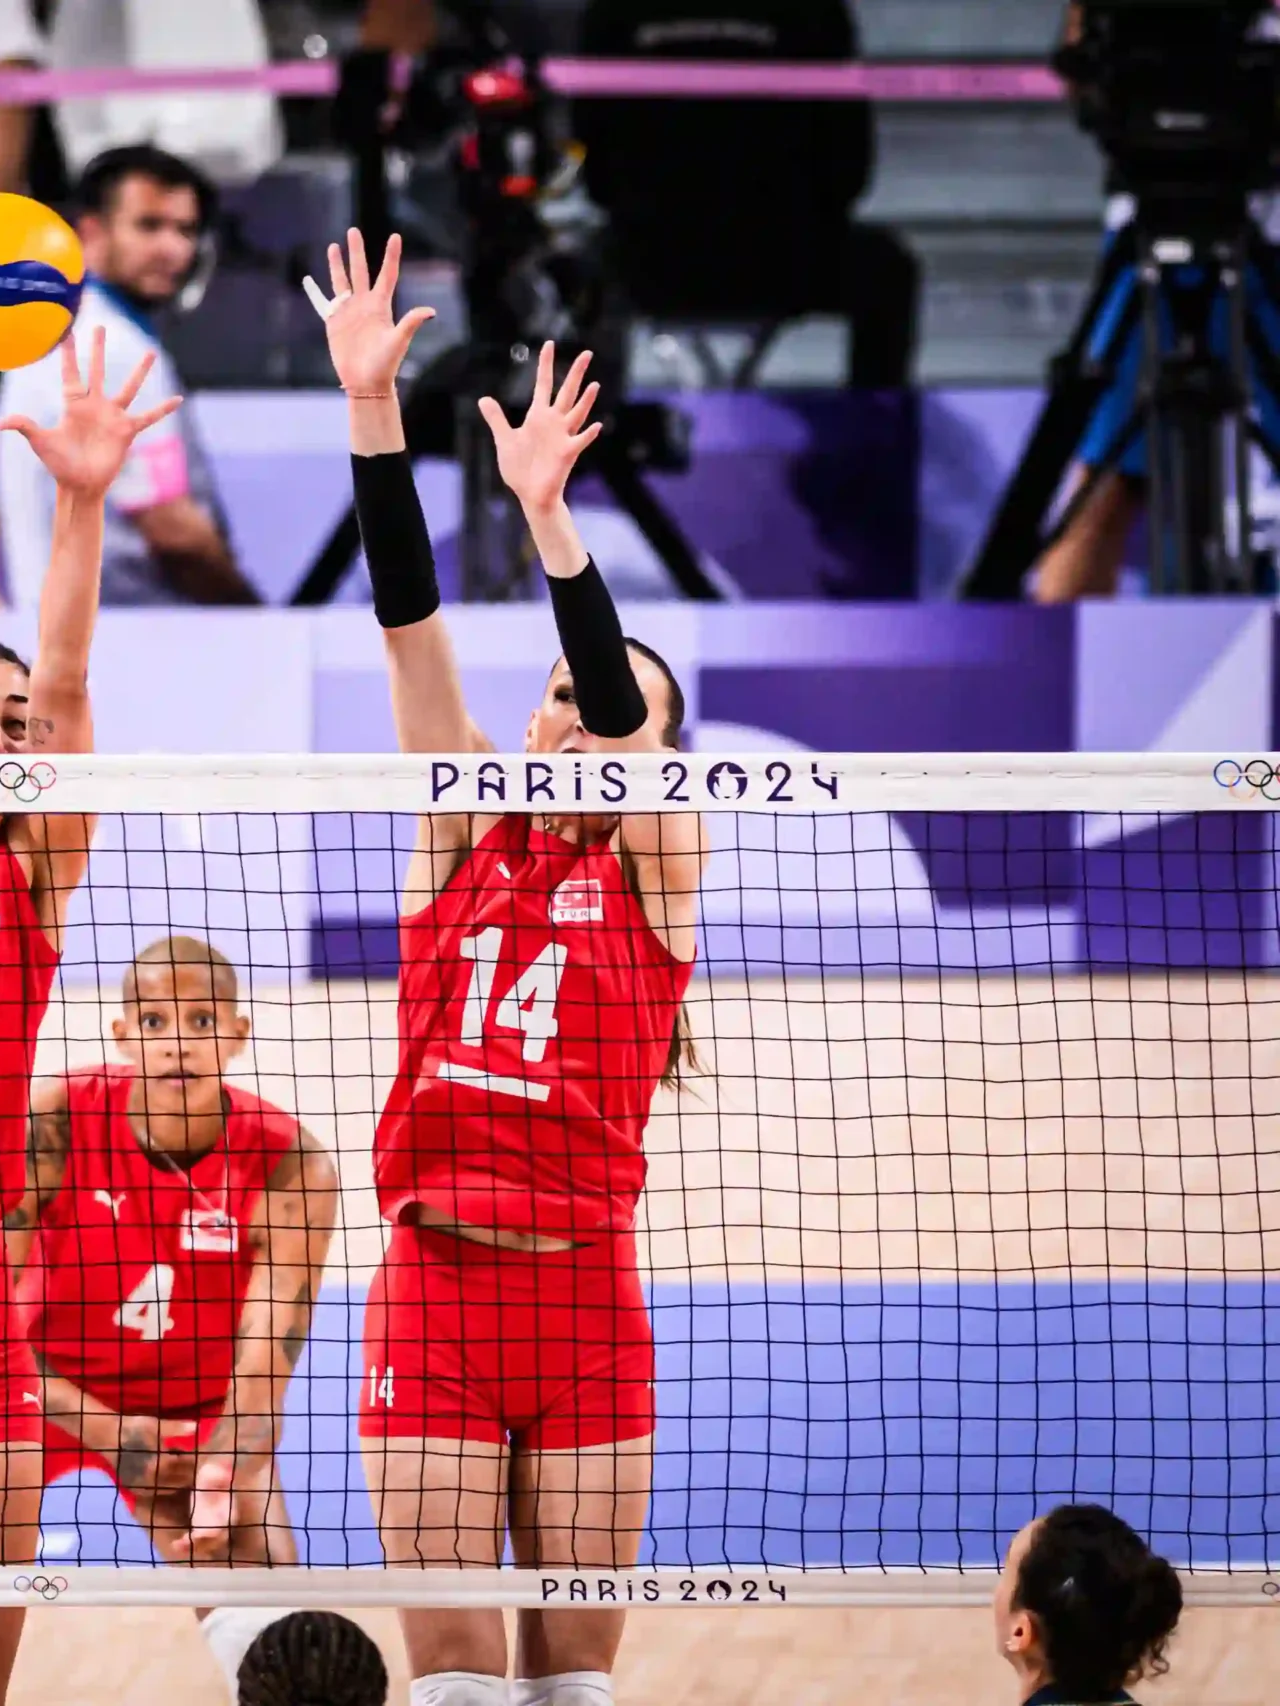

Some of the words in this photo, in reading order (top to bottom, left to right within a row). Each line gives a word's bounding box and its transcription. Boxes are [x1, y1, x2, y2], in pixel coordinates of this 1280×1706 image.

[662, 761, 839, 801] 2024
[559, 910, 589, 919] TUR
[460, 926, 568, 1063] 14
[112, 1263, 175, 1342] 4
[369, 1365, 395, 1407] 14
[678, 1580, 786, 1601] 2024
